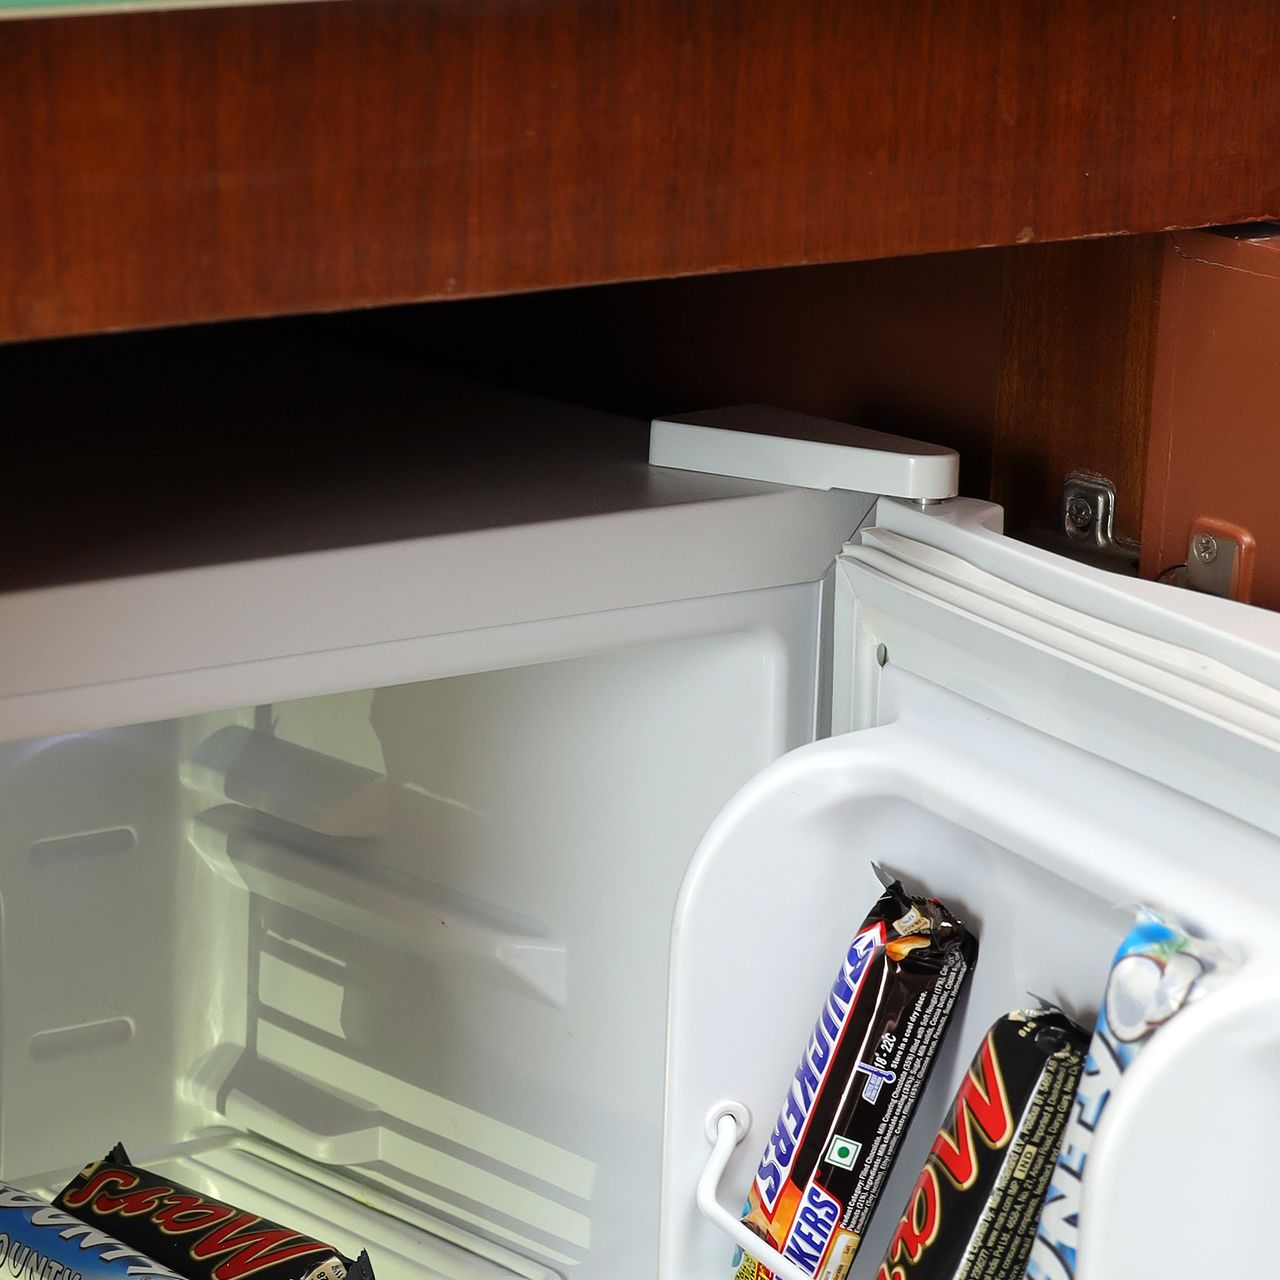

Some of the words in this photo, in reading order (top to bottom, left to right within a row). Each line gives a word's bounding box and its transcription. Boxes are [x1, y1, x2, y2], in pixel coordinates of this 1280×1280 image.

[913, 989, 929, 1012] place.
[925, 993, 941, 1015] Nougat
[908, 1010, 921, 1023] dry
[920, 1013, 931, 1026] Soft
[902, 1021, 914, 1037] cool
[915, 1026, 926, 1039] with
[897, 1041, 906, 1050] in
[909, 1038, 921, 1053] filled
[889, 1049, 903, 1069] Store
[891, 1070, 908, 1099] Chocolate
[881, 1097, 899, 1123] Covering
[876, 1121, 887, 1135] Milk
[882, 1115, 899, 1144] chocolate
[877, 1142, 888, 1157] Milk
[858, 1163, 871, 1179] Filled
[1016, 1149, 1033, 1173] IND
[863, 1155, 884, 1191] Ingredients:
[847, 1179, 866, 1207] Category:
[838, 1205, 854, 1229] Product
[846, 1208, 861, 1232] Peanuts
